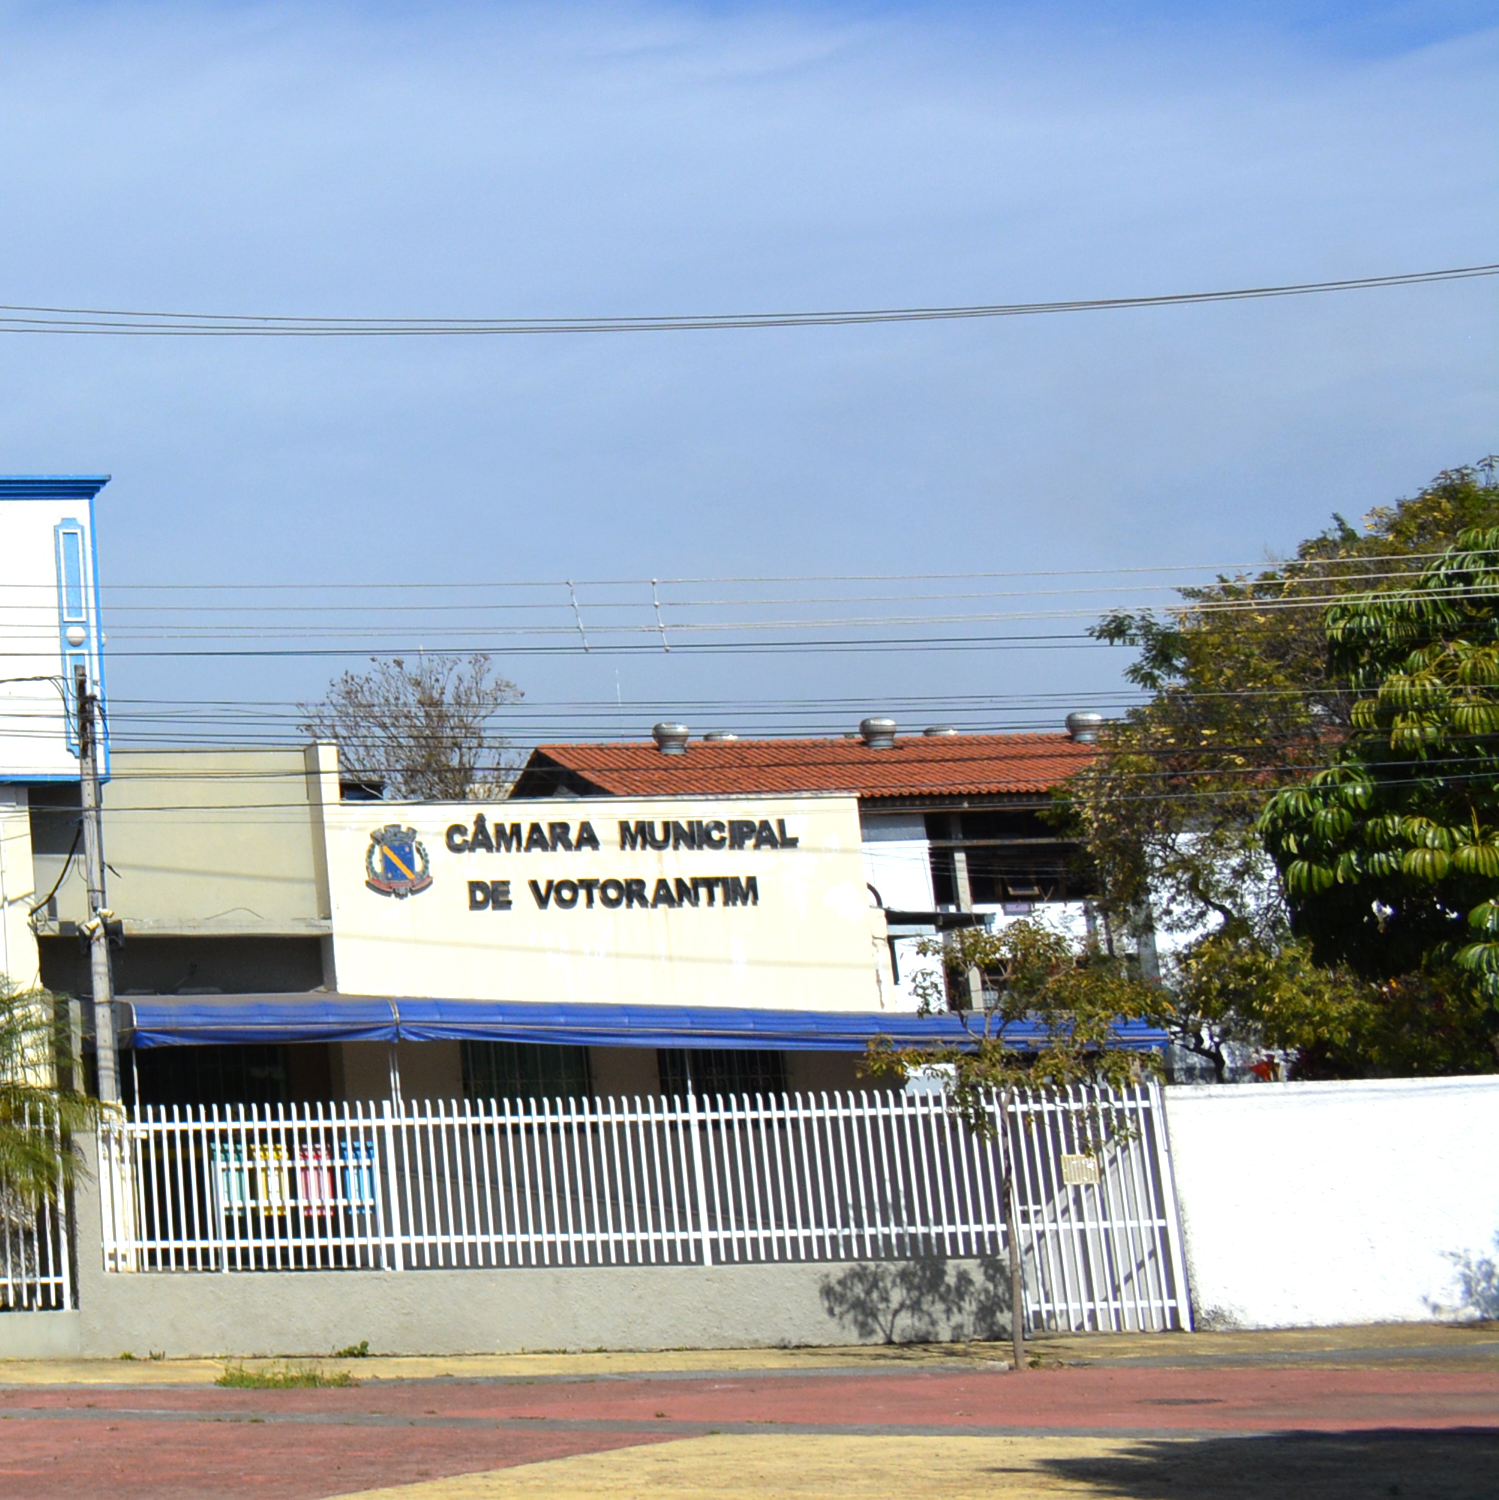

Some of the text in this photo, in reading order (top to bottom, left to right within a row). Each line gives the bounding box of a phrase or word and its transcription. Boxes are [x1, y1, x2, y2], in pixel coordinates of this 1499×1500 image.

[445, 813, 799, 853] CÂMARA MUNICIPAL
[467, 876, 759, 911] DE VOTORANTIM
